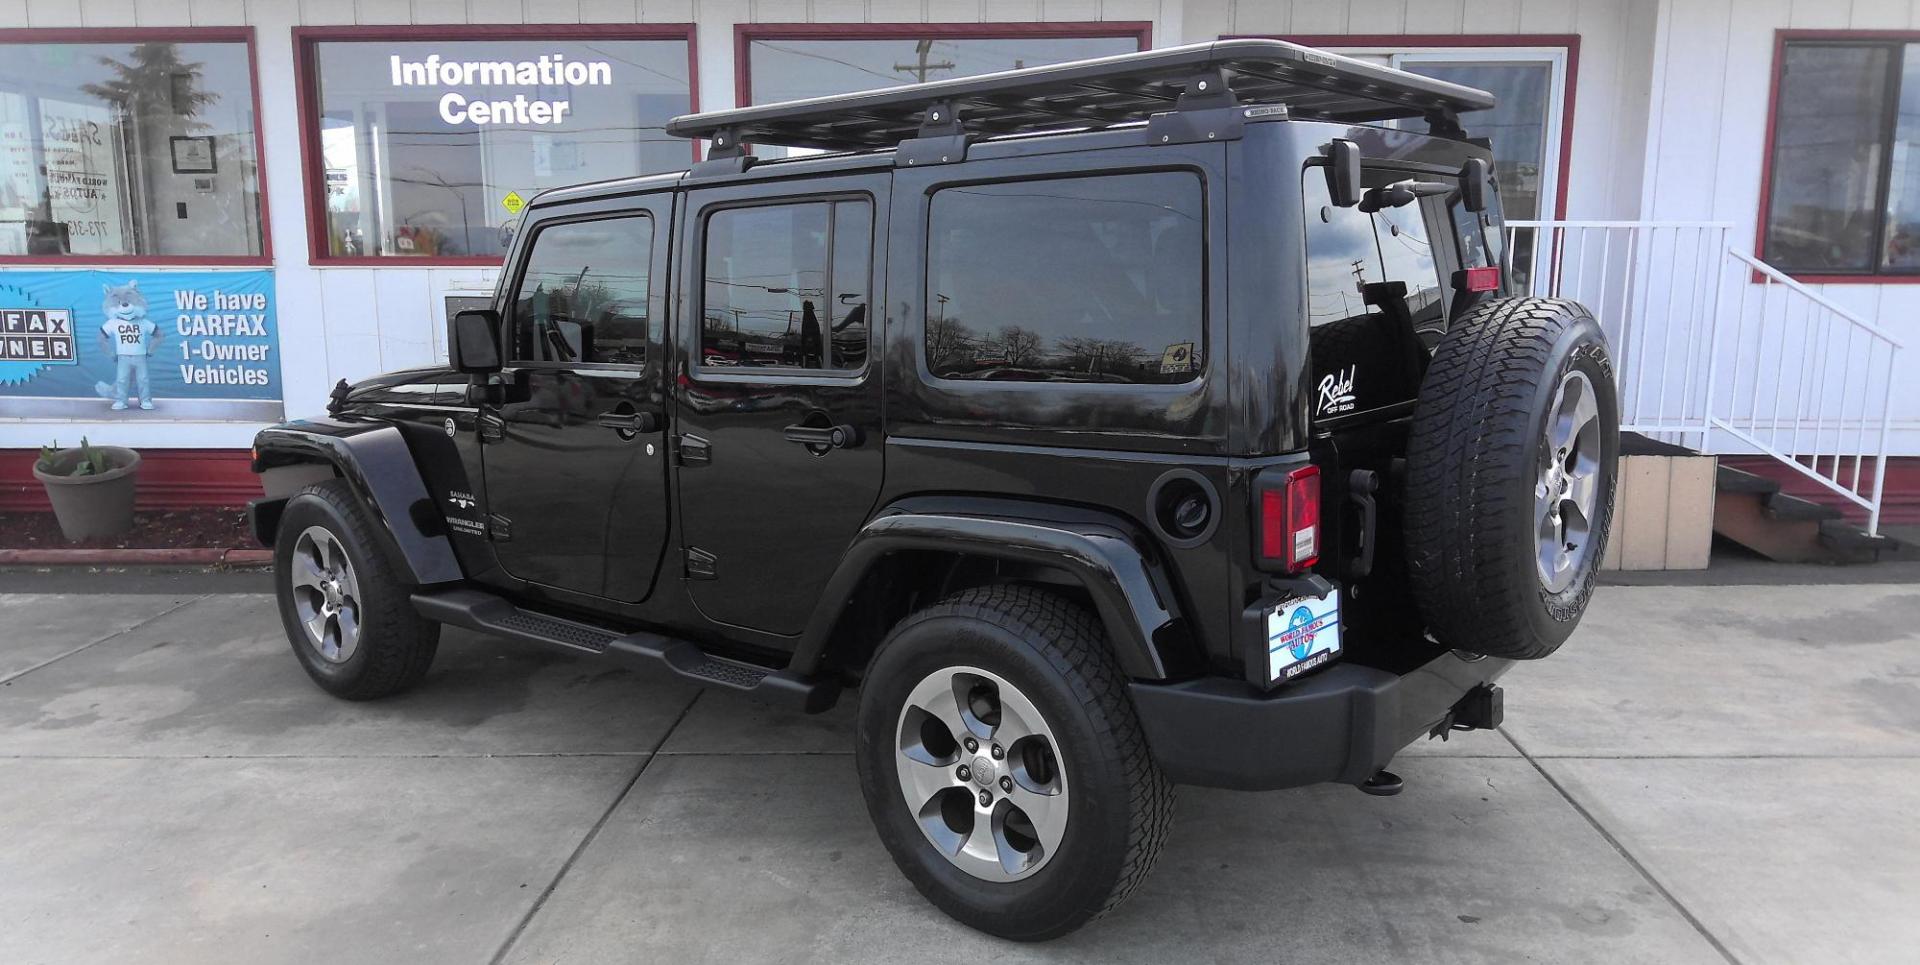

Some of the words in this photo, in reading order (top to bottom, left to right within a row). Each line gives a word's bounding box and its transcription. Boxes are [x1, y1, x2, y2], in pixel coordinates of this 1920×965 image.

[390, 53, 612, 86] Information
[439, 92, 569, 125] Center
[174, 290, 208, 311] We
[213, 289, 266, 311] have
[118, 324, 141, 334] CAR
[176, 314, 267, 336] CARFAX
[120, 335, 141, 344] FOX
[179, 339, 269, 361] 1-Owner
[180, 364, 268, 385] Vehicles
[1316, 364, 1356, 416] Rebel
[1327, 406, 1338, 414] OFF
[1339, 403, 1355, 411] ROAD
[445, 516, 485, 530] WRANGLER
[1280, 629, 1300, 643] WORLD
[1301, 620, 1323, 634] FAMOUS
[1290, 633, 1314, 649] AUTOS
[1286, 663, 1301, 678] WORLD
[1301, 657, 1317, 671] FAMOUS
[1317, 653, 1328, 666] AUTO
